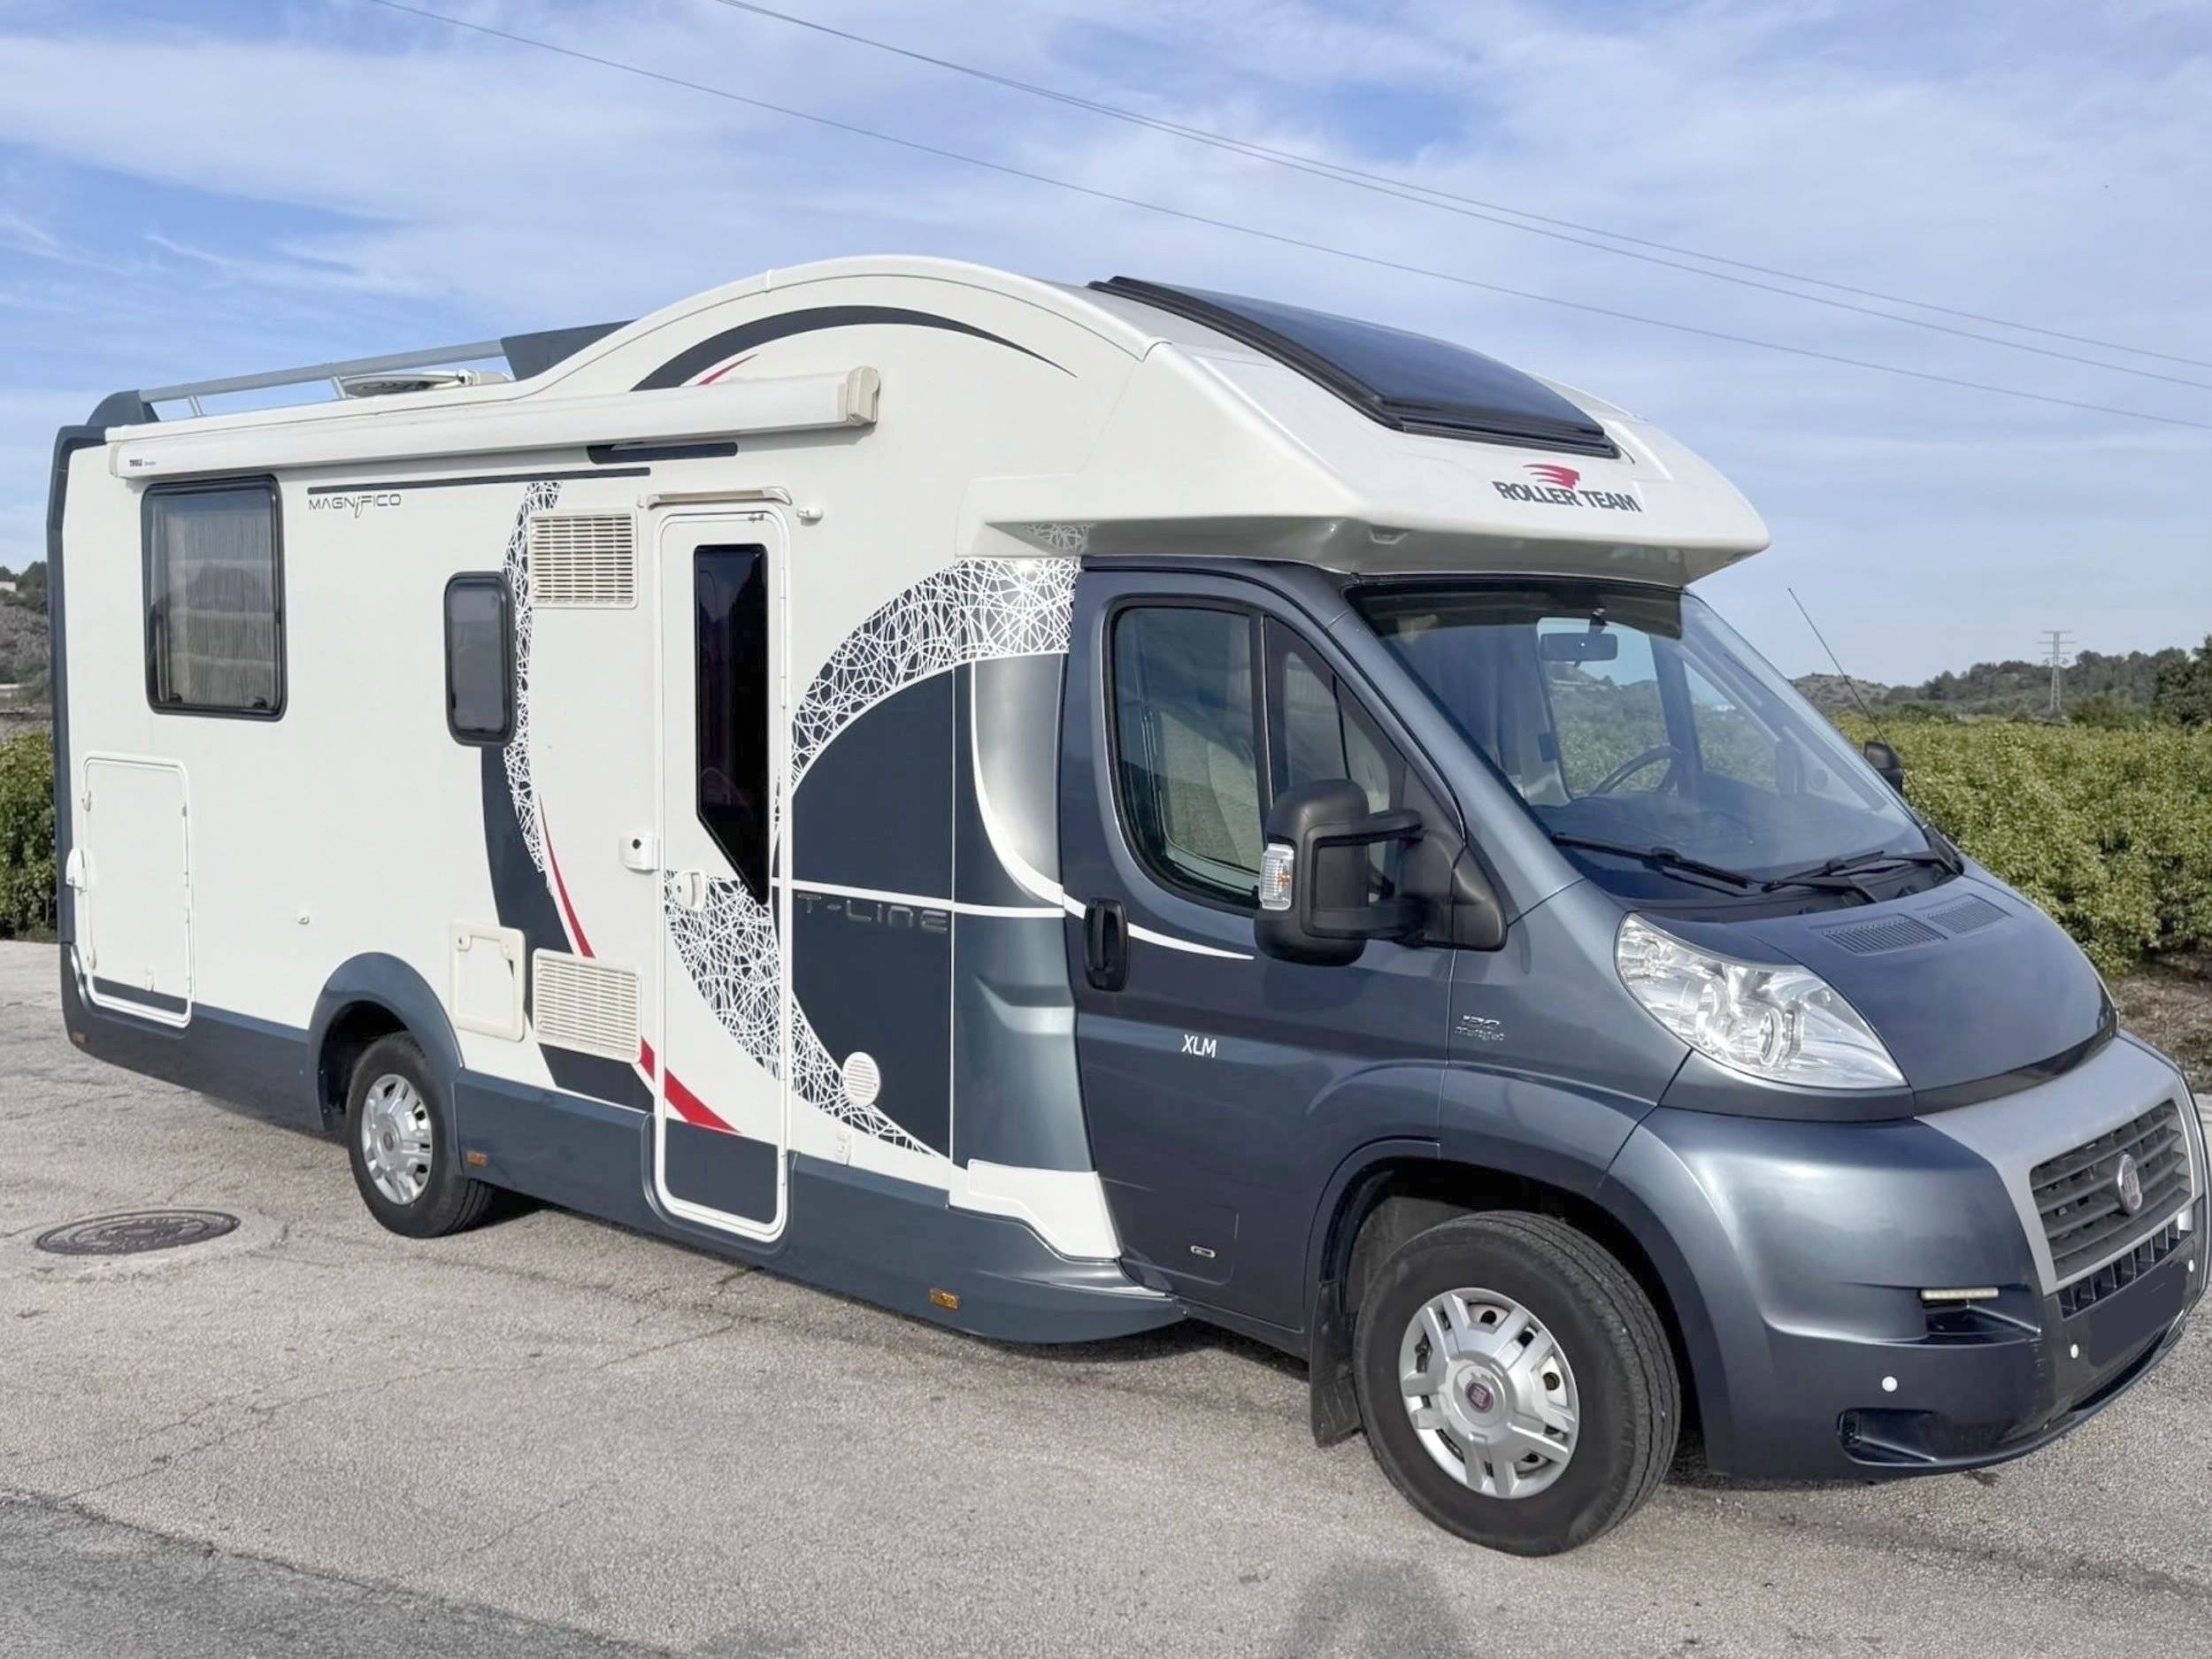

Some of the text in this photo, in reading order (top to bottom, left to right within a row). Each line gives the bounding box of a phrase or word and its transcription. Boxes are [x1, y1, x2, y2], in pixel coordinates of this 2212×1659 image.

[1493, 480, 1642, 512] ROLLER TEAM
[1181, 1033, 1217, 1058] XLM
